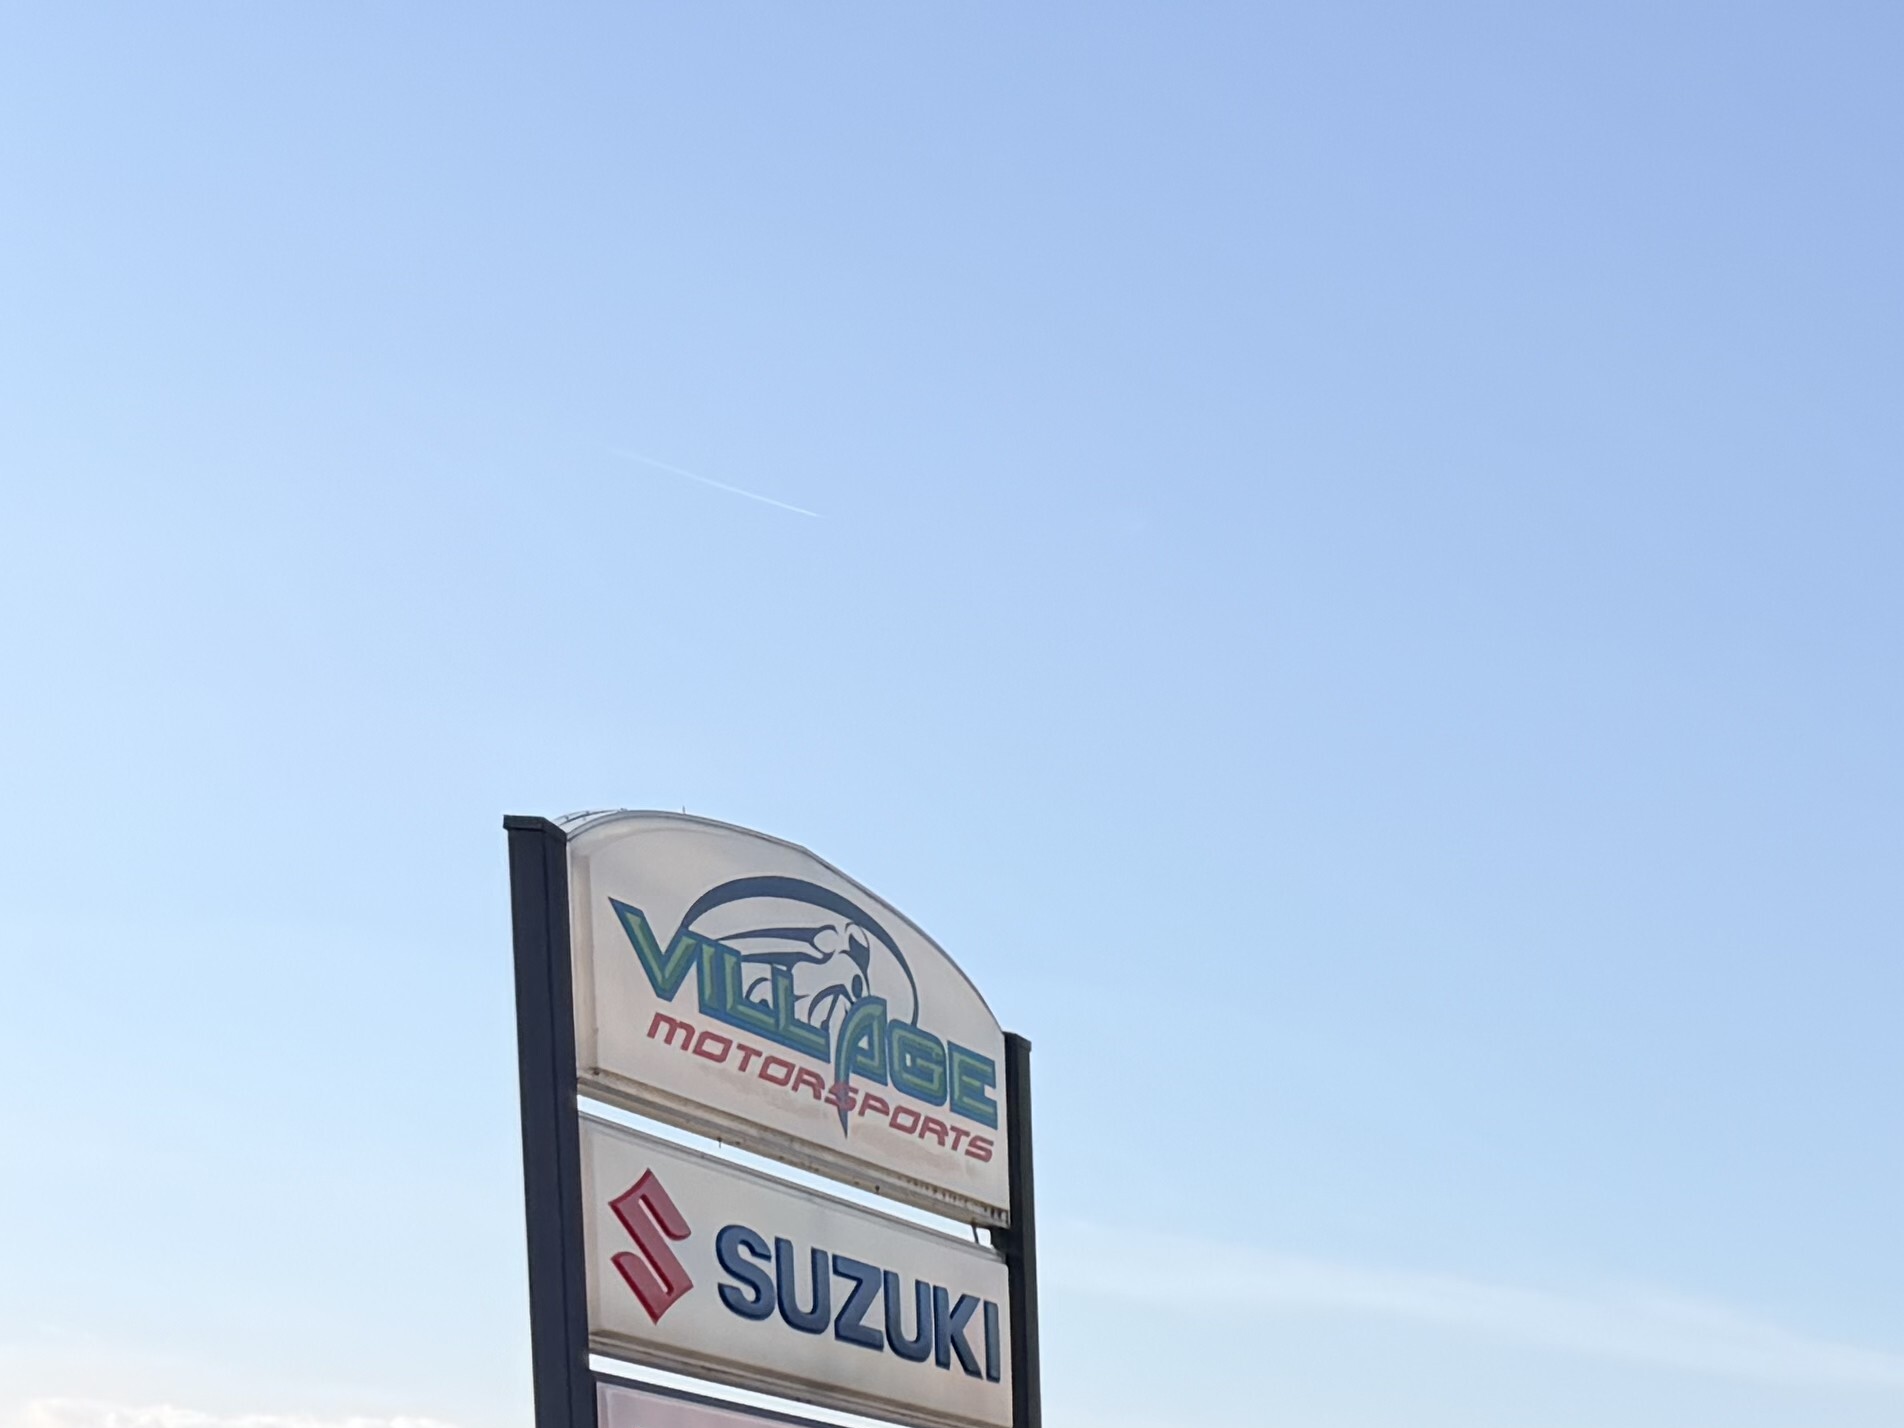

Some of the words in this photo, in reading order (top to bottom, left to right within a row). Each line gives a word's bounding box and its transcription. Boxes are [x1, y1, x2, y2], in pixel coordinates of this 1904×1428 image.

[607, 896, 999, 1138] VILLAGE
[646, 1012, 995, 1163] MOTORSPORTS
[715, 1224, 1001, 1384] SUZUKI
